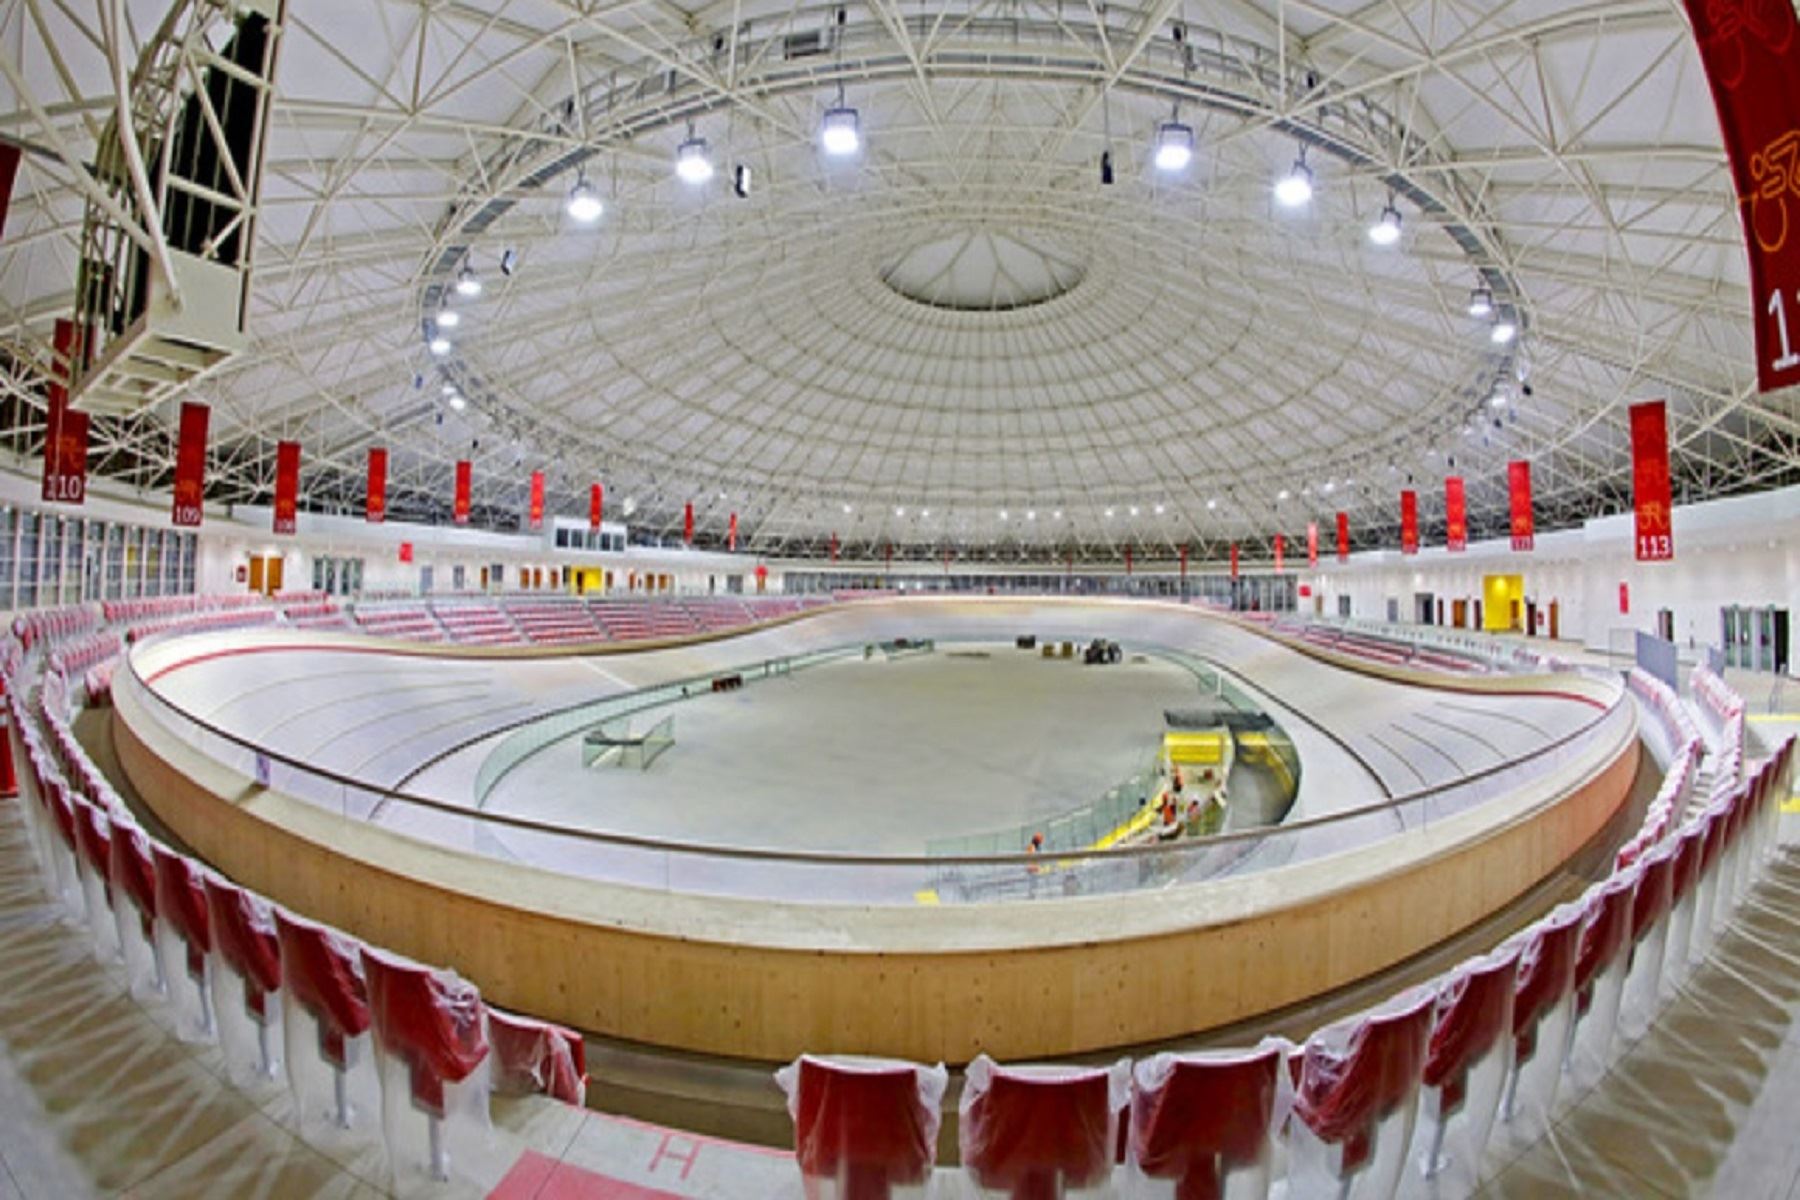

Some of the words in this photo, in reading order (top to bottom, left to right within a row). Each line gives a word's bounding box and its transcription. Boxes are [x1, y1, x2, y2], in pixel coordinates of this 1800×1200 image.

[46, 474, 82, 499] 110
[175, 506, 200, 524] 109
[1639, 535, 1671, 557] 113
